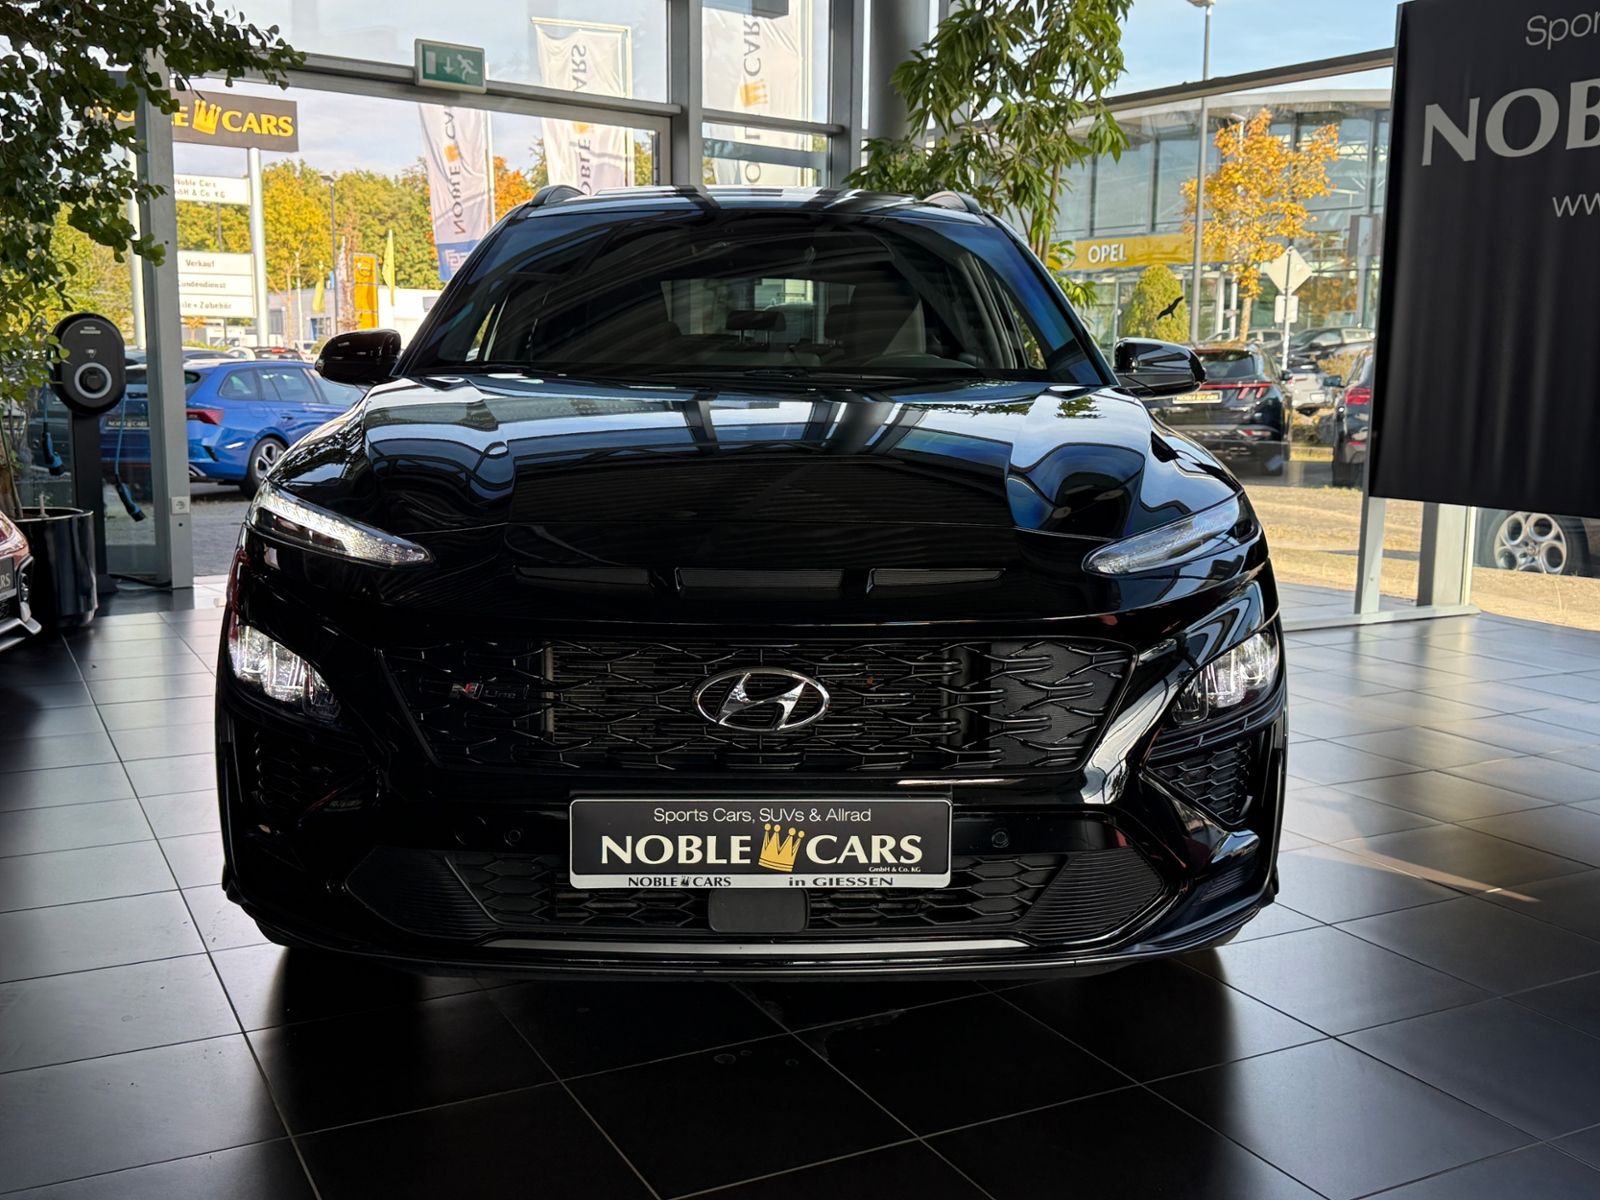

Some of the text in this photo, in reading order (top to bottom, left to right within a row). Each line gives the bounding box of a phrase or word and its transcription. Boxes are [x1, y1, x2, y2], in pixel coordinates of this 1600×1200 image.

[221, 110, 294, 137] CARS
[199, 179, 216, 187] Cars
[1087, 243, 1127, 264] OPEL
[185, 259, 215, 268] Verkauf
[653, 807, 871, 824] Sports Cars, SUVs & Allrad
[601, 834, 923, 864] NOBLE CARS
[628, 876, 732, 887] NOBLE CARS
[789, 877, 893, 887] in GIESSEN
